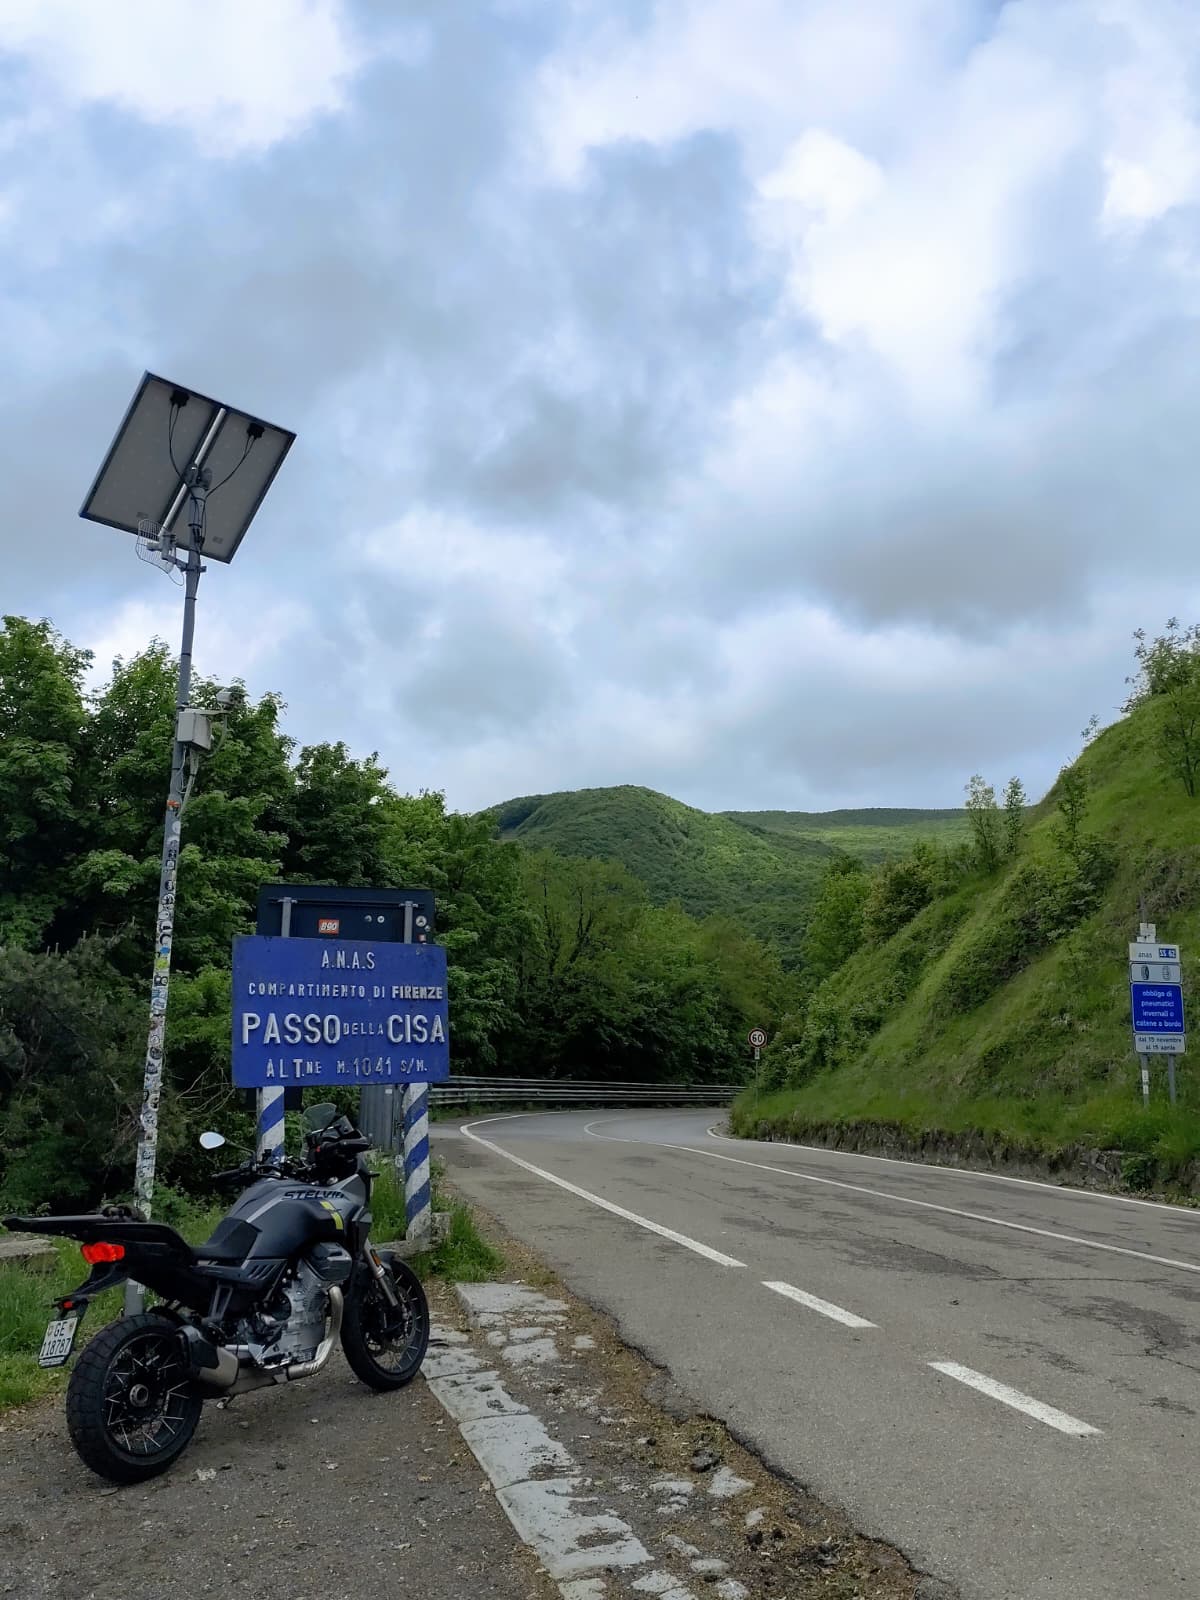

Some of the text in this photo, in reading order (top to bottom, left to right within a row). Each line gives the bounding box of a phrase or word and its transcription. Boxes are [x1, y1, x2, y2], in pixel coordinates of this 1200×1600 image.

[248, 982, 443, 999] COMPARTIMENTO DI FIRENZE
[242, 1013, 445, 1044] PASSO DELLA CISA
[353, 1056, 392, 1076] 1041
[281, 1190, 345, 1201] STELVIO
[54, 1321, 68, 1337] GE
[41, 1337, 71, 1357] 118787
